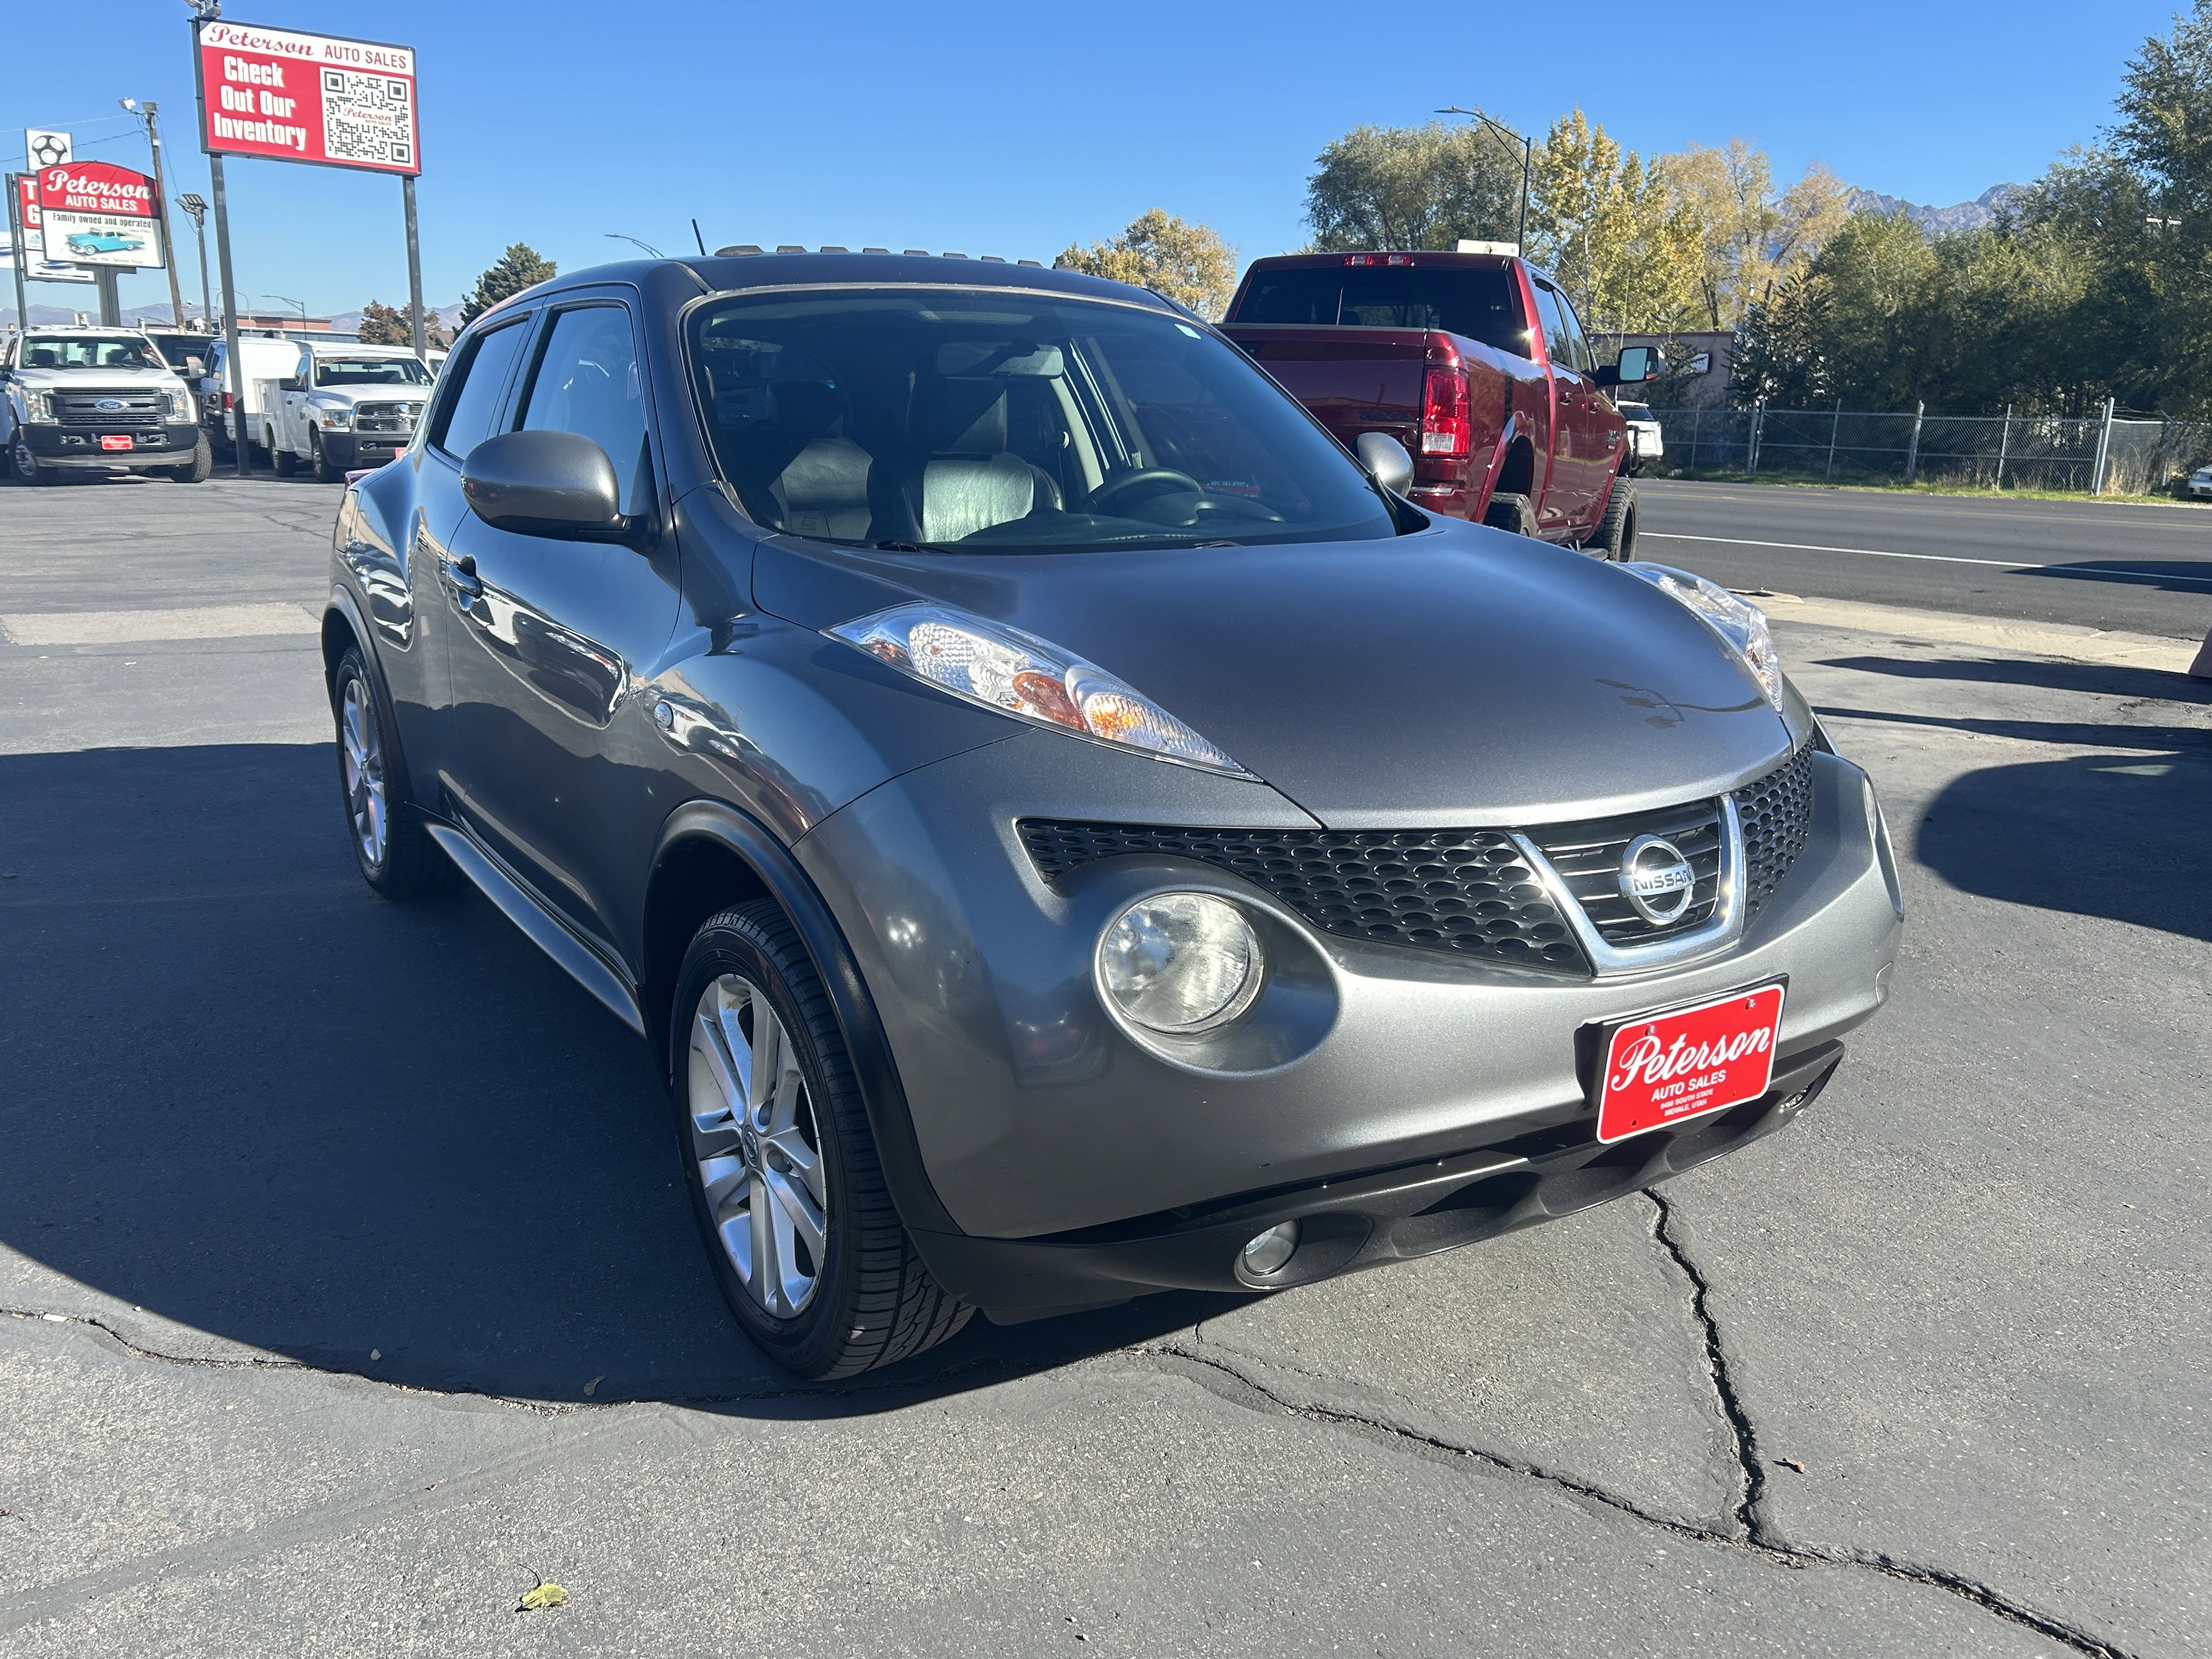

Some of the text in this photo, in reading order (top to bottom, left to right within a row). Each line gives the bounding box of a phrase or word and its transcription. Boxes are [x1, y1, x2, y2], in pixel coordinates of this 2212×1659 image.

[208, 25, 407, 70] Peterson AUTO SALES
[223, 55, 284, 88] Check
[221, 85, 296, 119] Out Our
[343, 108, 392, 121] Peterson
[213, 112, 307, 151] Inventory
[46, 170, 152, 200] Peterson
[65, 195, 137, 211] AUTO SALES
[53, 213, 151, 228] Family owned and operated
[1633, 869, 1692, 891] NISSAN
[1611, 1026, 1771, 1091] Peterson
[1650, 1070, 1726, 1102] AUTO SALES
[1674, 1094, 1696, 1105] SOUTH
[1696, 1088, 1714, 1099] STATE
[1691, 1098, 1707, 1109] UTAH
